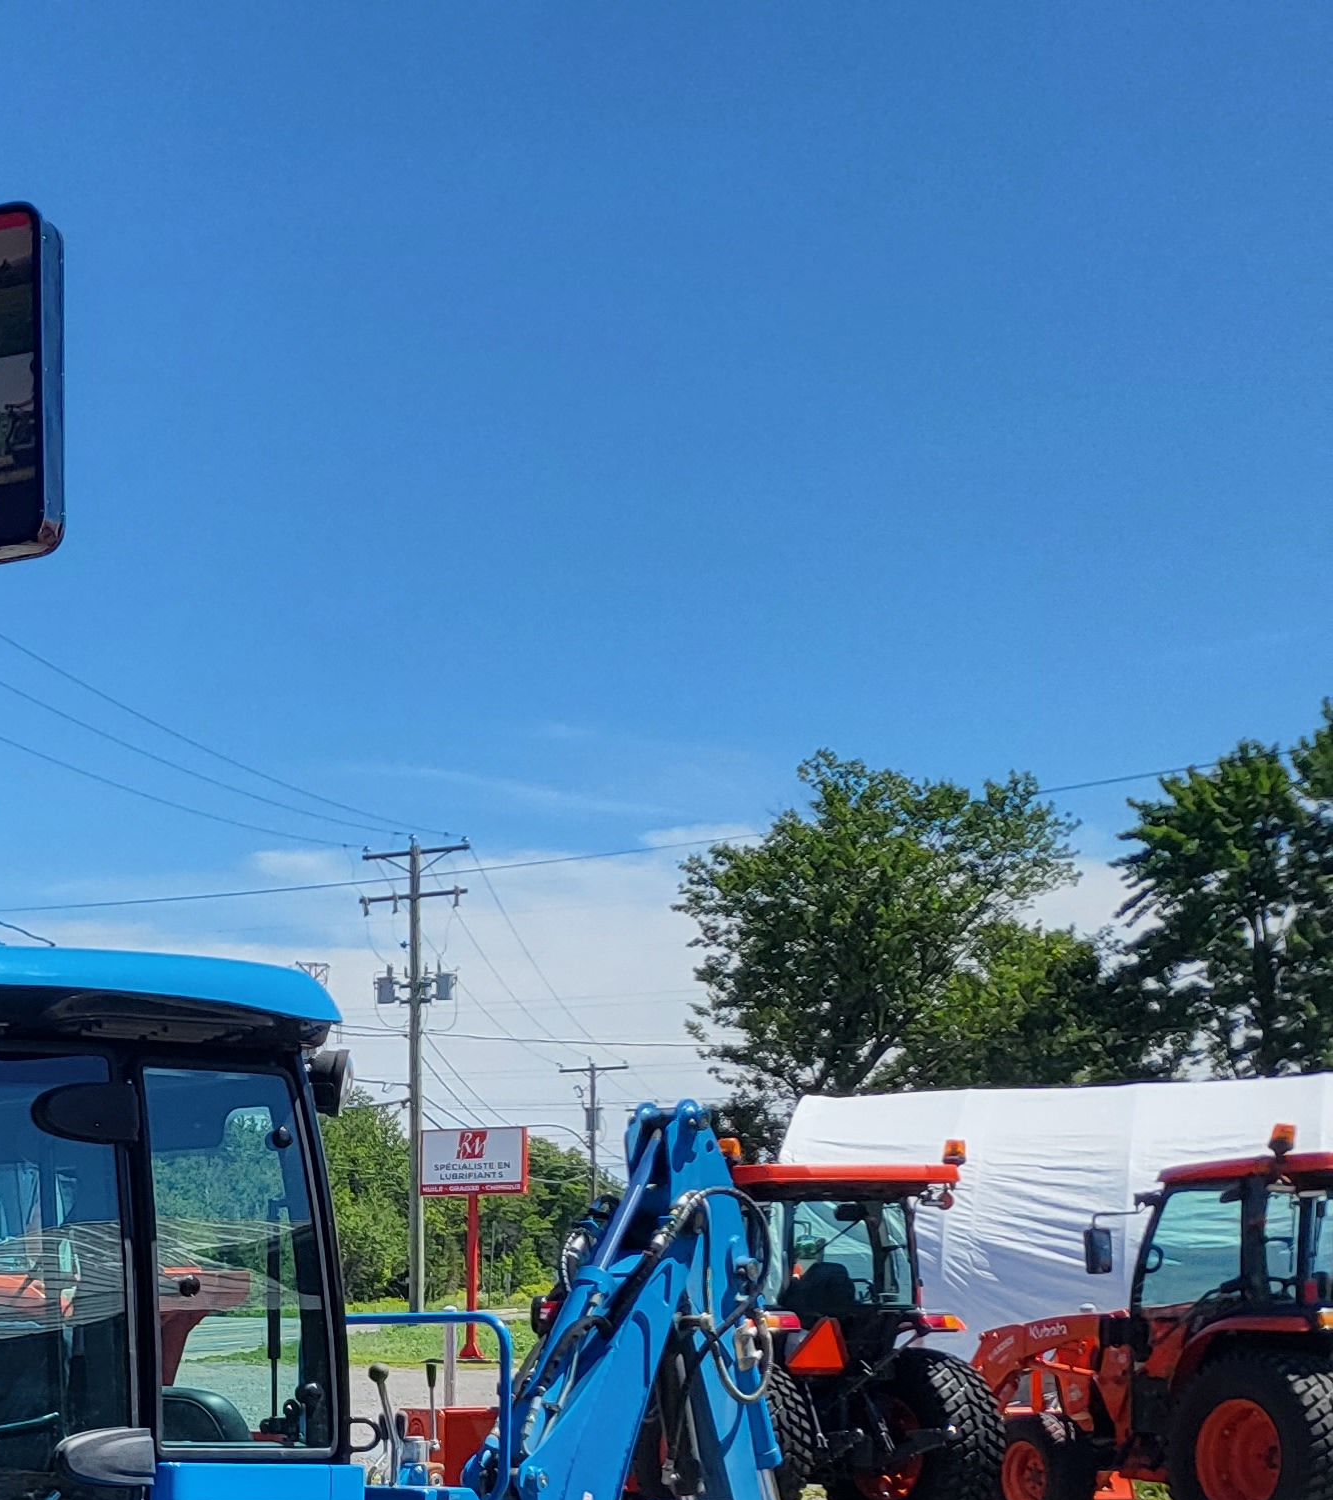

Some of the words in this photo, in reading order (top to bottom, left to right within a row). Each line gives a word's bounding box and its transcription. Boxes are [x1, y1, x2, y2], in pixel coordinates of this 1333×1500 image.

[497, 1161, 511, 1170] EN
[439, 1171, 504, 1180] LUBRIFIANTS
[1029, 1322, 1067, 1339] Kubota
